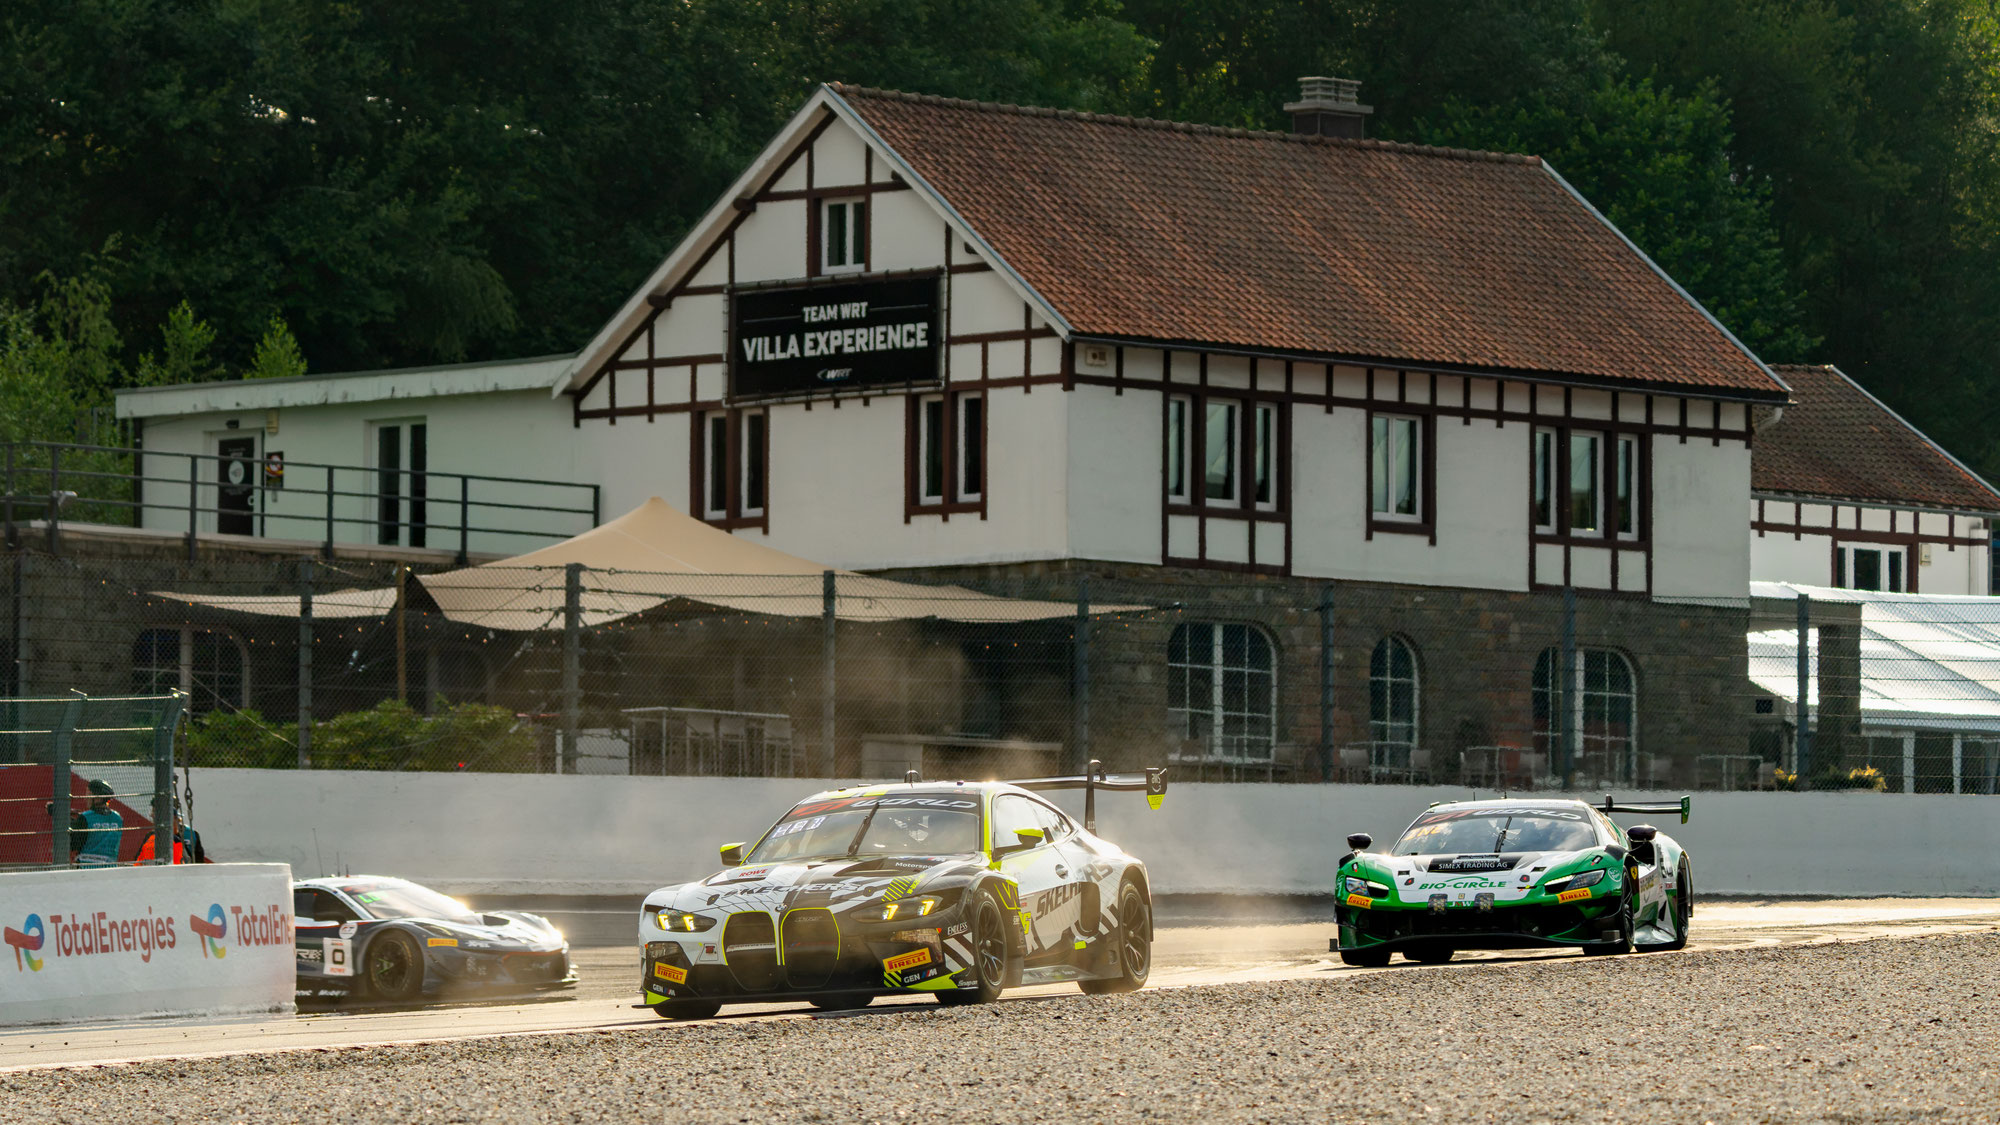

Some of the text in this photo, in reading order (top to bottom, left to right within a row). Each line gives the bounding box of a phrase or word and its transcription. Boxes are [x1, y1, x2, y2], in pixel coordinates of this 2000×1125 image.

[802, 302, 868, 323] TEAM WRT
[742, 322, 929, 362] VILLA EXPERIENCE
[851, 798, 978, 809] WORLD
[1472, 808, 1582, 821] WORLD
[895, 861, 934, 869] Motorspo
[1438, 862, 1461, 870] SIMEX
[1463, 861, 1495, 869] TRADING
[738, 868, 768, 878] ROWE
[1418, 880, 1507, 890] BIO-CIRCLE
[1348, 894, 1370, 907] PIRELLI
[1560, 889, 1589, 901] PIRELLI
[50, 905, 176, 963] TotalEnergies
[947, 921, 968, 936] ENDLESS
[887, 951, 928, 970] PIRELLI
[657, 965, 684, 981] PIRELLI
[903, 973, 920, 983] GEN
[652, 984, 664, 993] GEN
